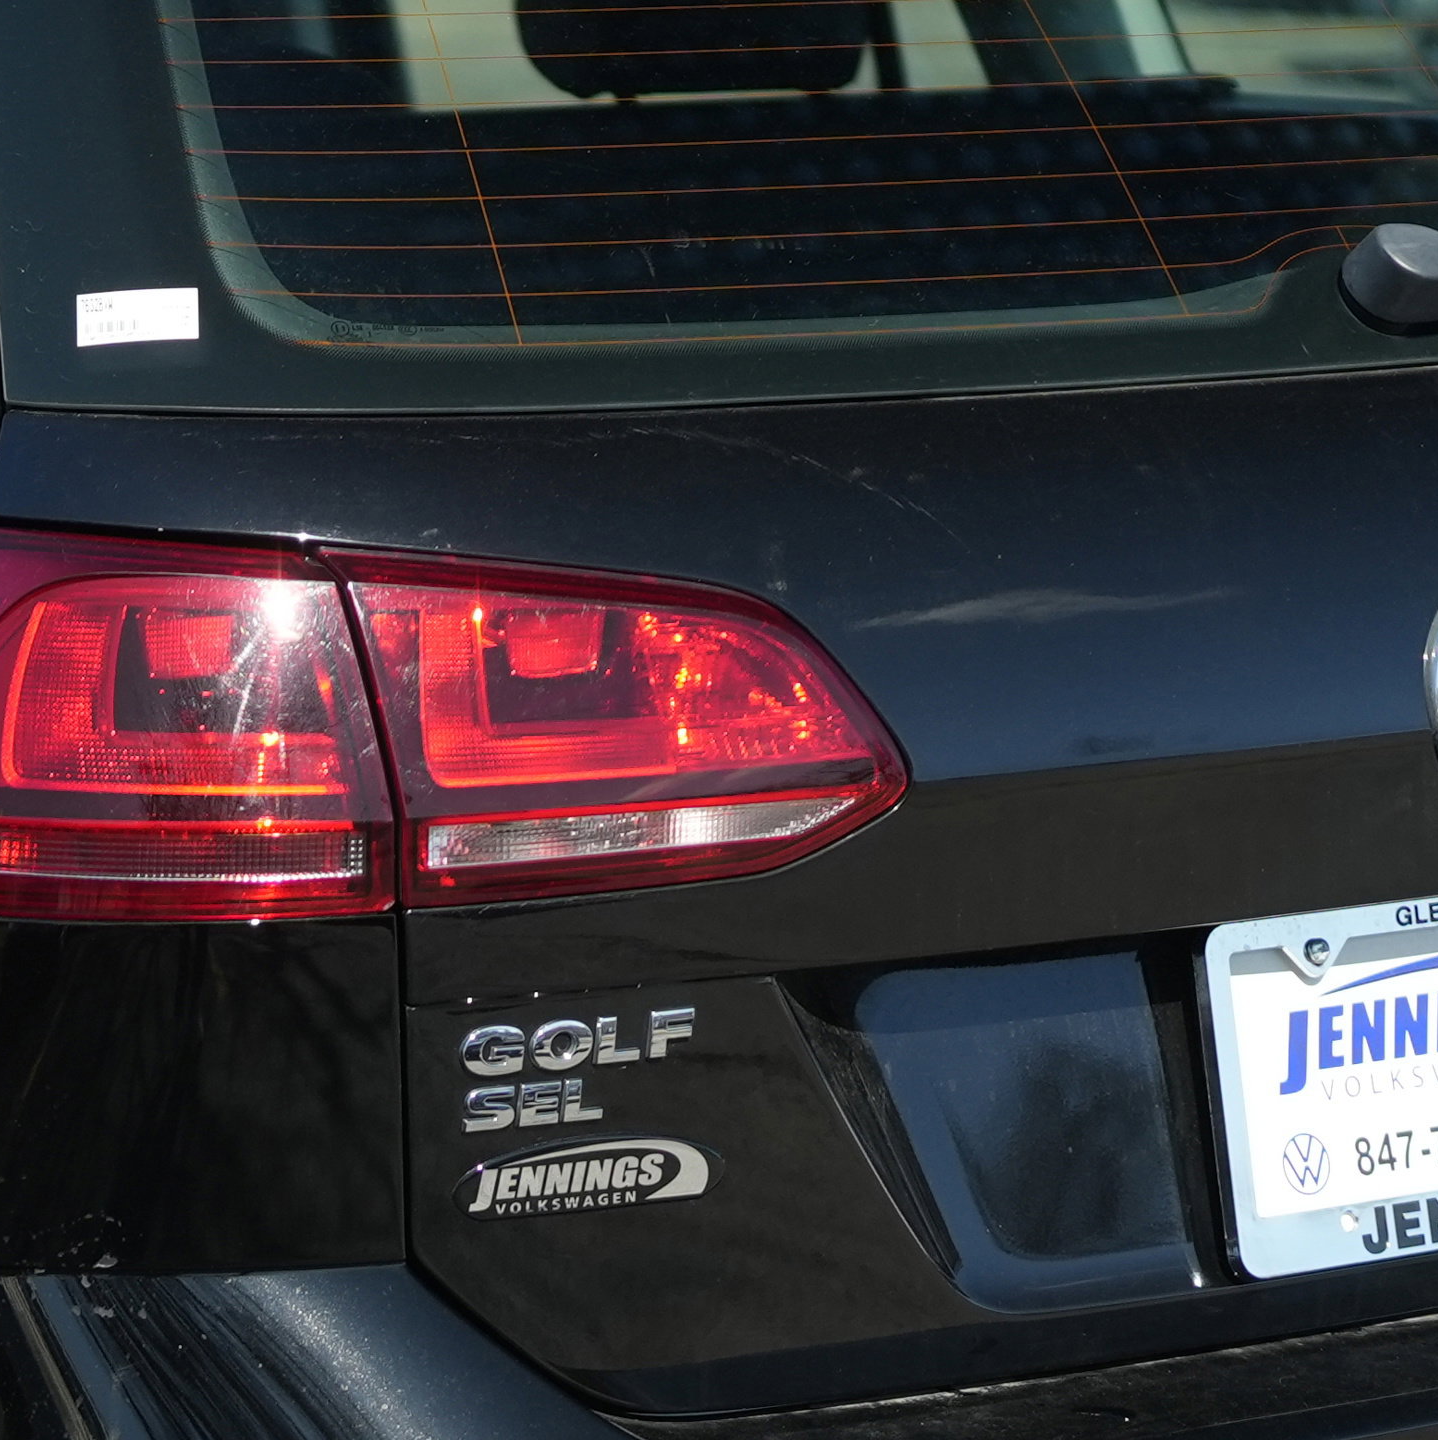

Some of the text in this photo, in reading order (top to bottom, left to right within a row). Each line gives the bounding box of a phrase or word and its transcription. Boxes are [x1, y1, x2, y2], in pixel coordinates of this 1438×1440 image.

[460, 1007, 695, 1076] GOLF
[461, 1078, 603, 1133] SEL
[468, 1153, 664, 1212] JENNINGS
[495, 1190, 637, 1215] VOLKSWAGEN
